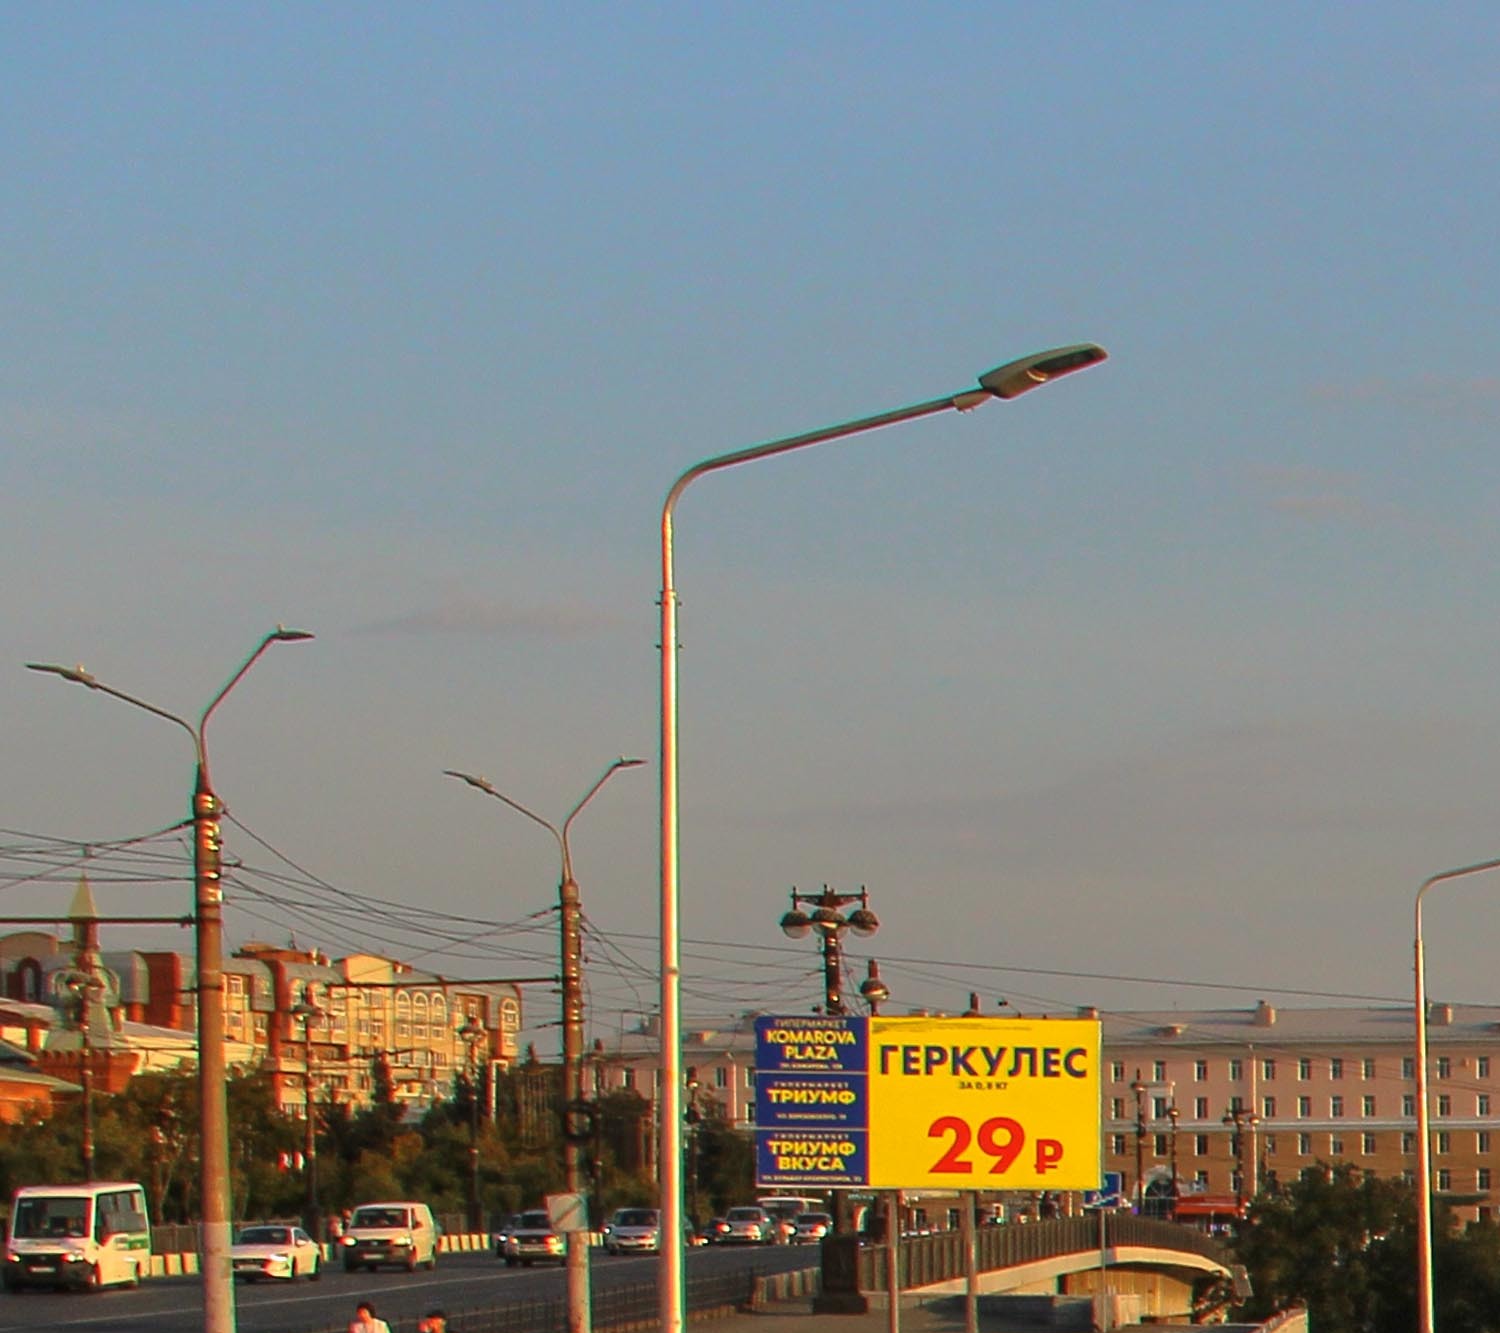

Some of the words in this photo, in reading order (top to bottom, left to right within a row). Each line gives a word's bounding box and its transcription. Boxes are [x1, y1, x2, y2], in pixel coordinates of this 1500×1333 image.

[765, 1030, 856, 1045] KOMAROVA
[784, 1045, 838, 1060] PLAZA
[880, 1045, 1087, 1078] ГЕРКУЛЕС
[766, 1088, 856, 1104] ТРИУМФ
[766, 1140, 856, 1155] ТРИУМФ
[928, 1116, 1025, 1174] 29
[777, 1156, 846, 1171] ВКУСА
